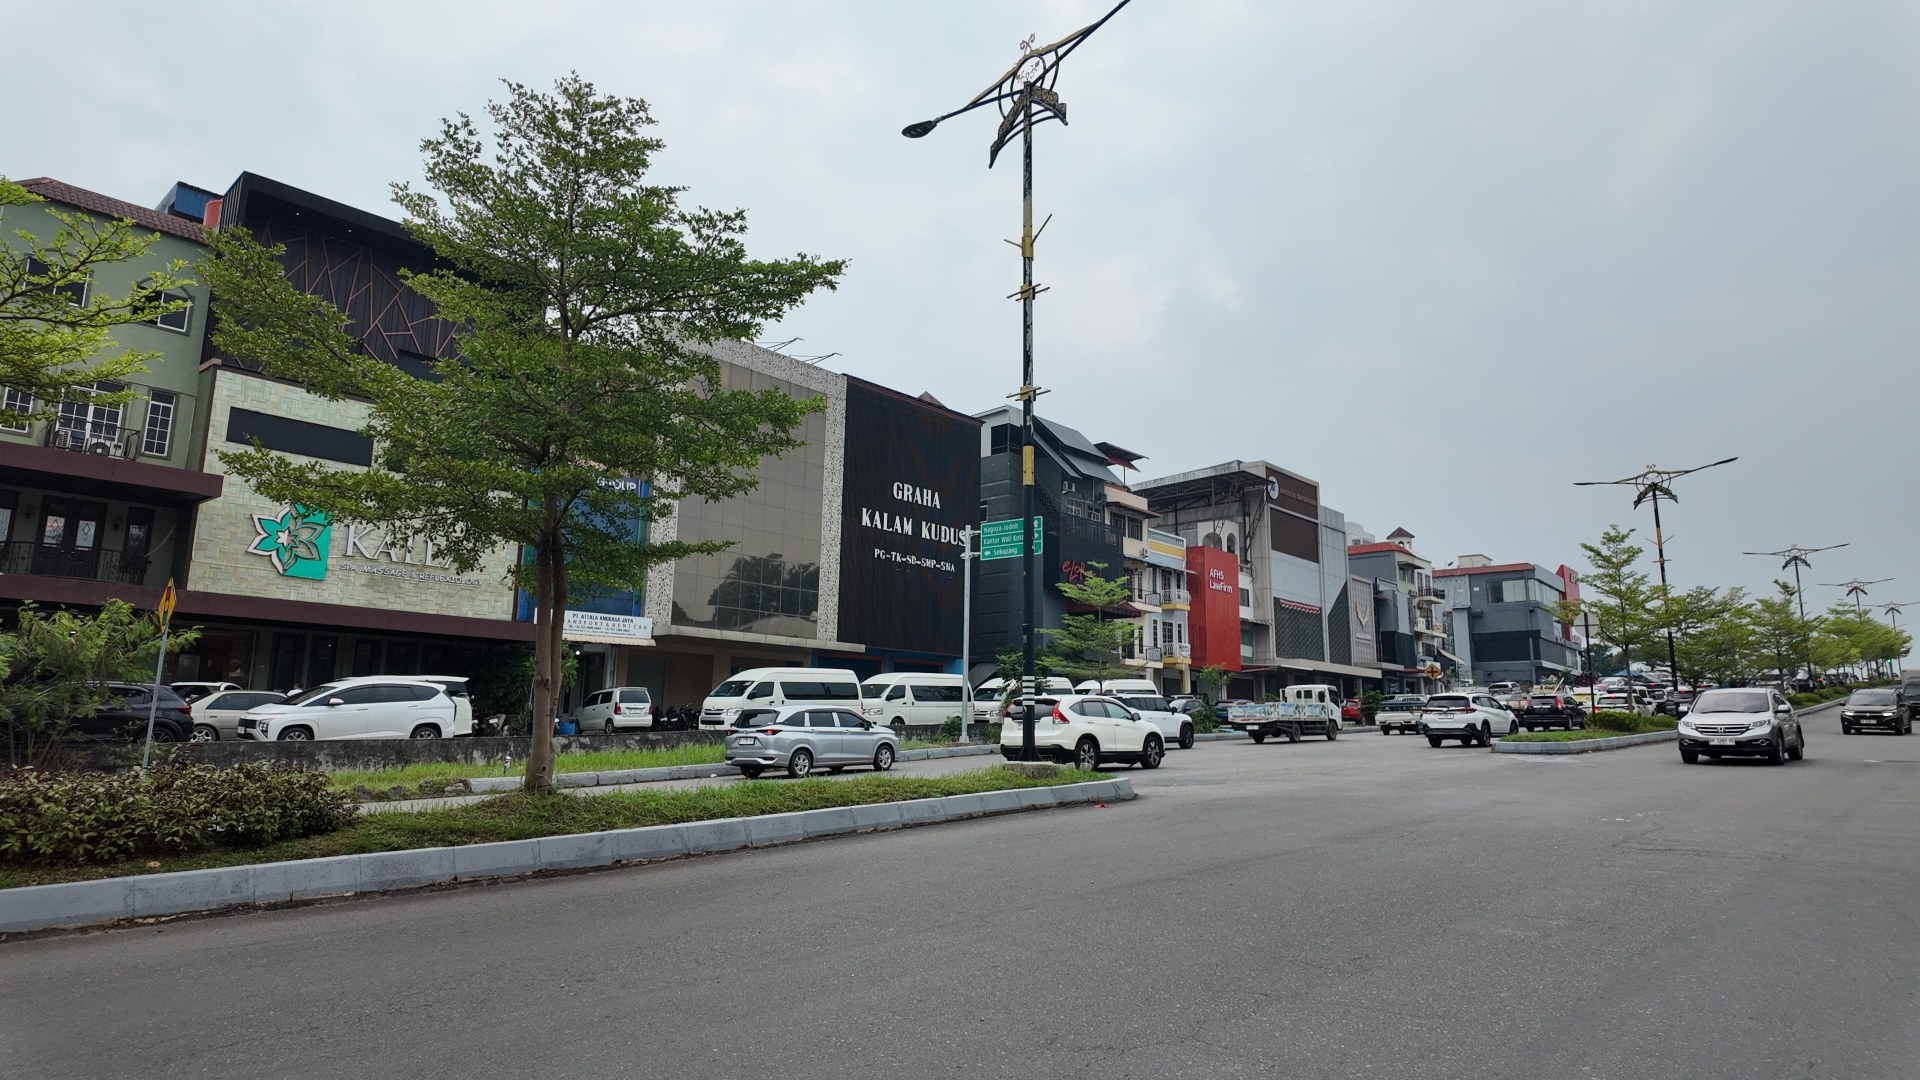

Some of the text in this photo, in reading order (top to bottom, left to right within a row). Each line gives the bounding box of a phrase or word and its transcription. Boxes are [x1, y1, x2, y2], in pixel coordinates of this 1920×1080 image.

[892, 481, 941, 509] GRAHA
[861, 507, 966, 547] KALAM KUDUS
[983, 522, 1019, 534] Nagoya-Jodoh
[344, 523, 453, 569] KALE
[983, 536, 1000, 545] Kantor
[1001, 535, 1012, 543] Wali
[993, 547, 1018, 556] Sekupang
[340, 562, 357, 572] SPA
[363, 565, 407, 577] MASSAGE
[1209, 568, 1224, 580] AFHS
[1209, 579, 1233, 594] LawFirm
